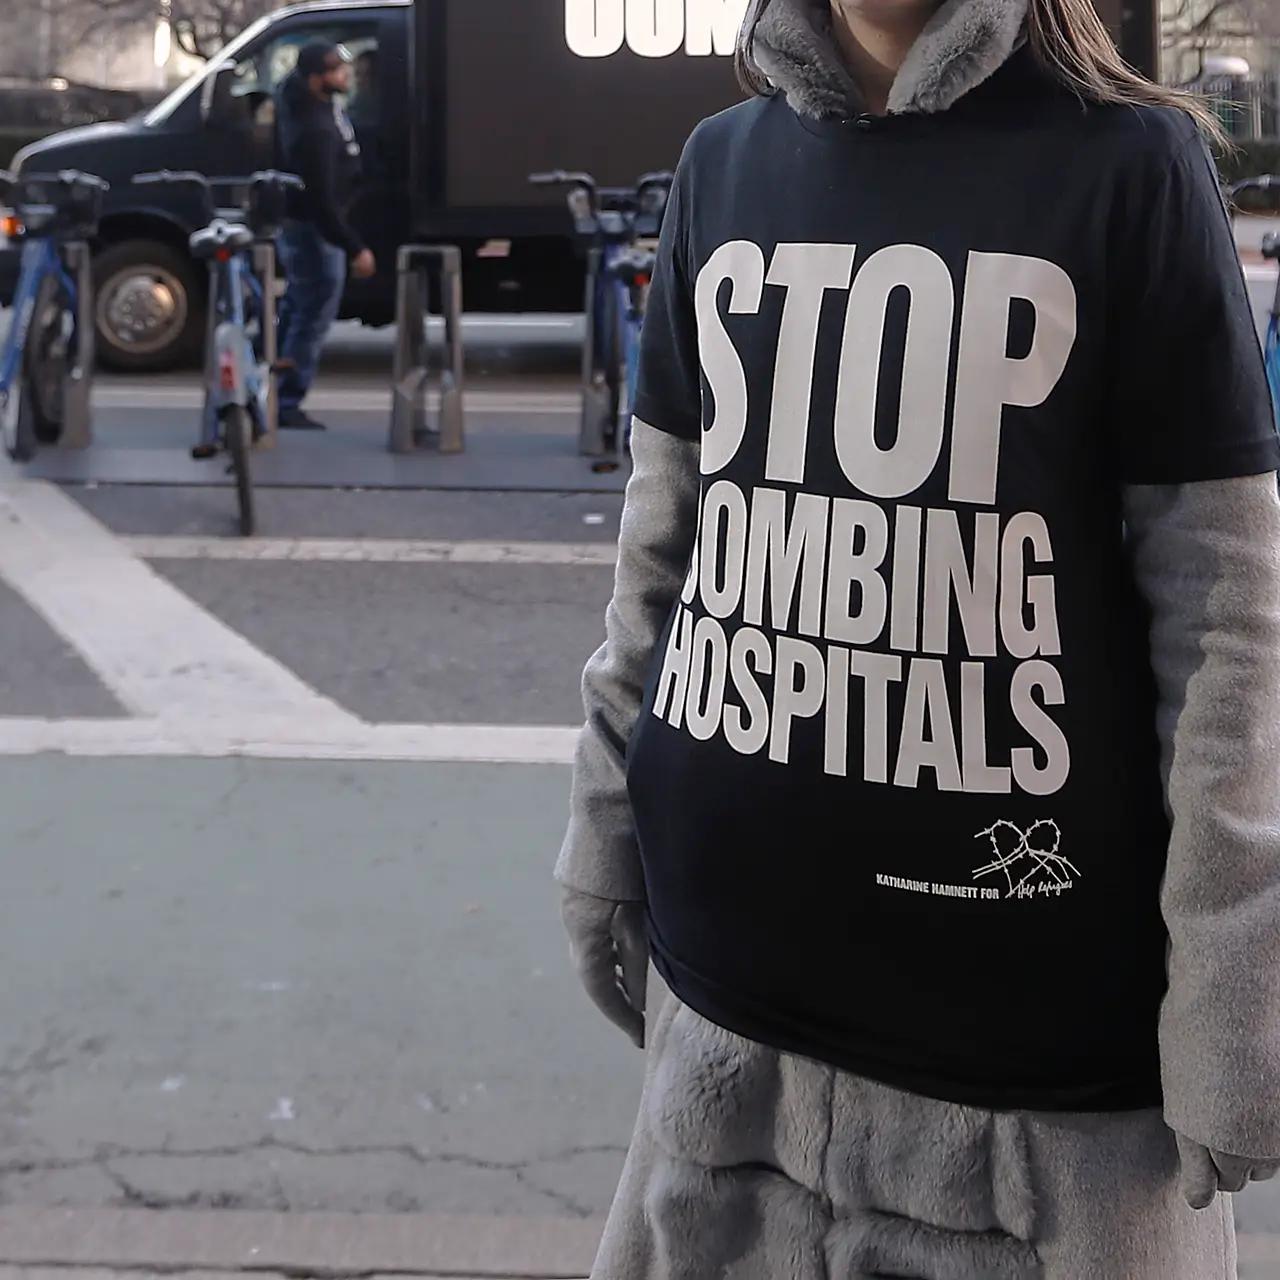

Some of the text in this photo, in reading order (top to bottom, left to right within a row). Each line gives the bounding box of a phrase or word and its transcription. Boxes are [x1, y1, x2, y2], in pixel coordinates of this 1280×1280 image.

[694, 239, 1077, 506] STOP
[652, 603, 1071, 796] HOSPITALS
[876, 873, 1000, 900] KATHARINE HAMNETT FOR
